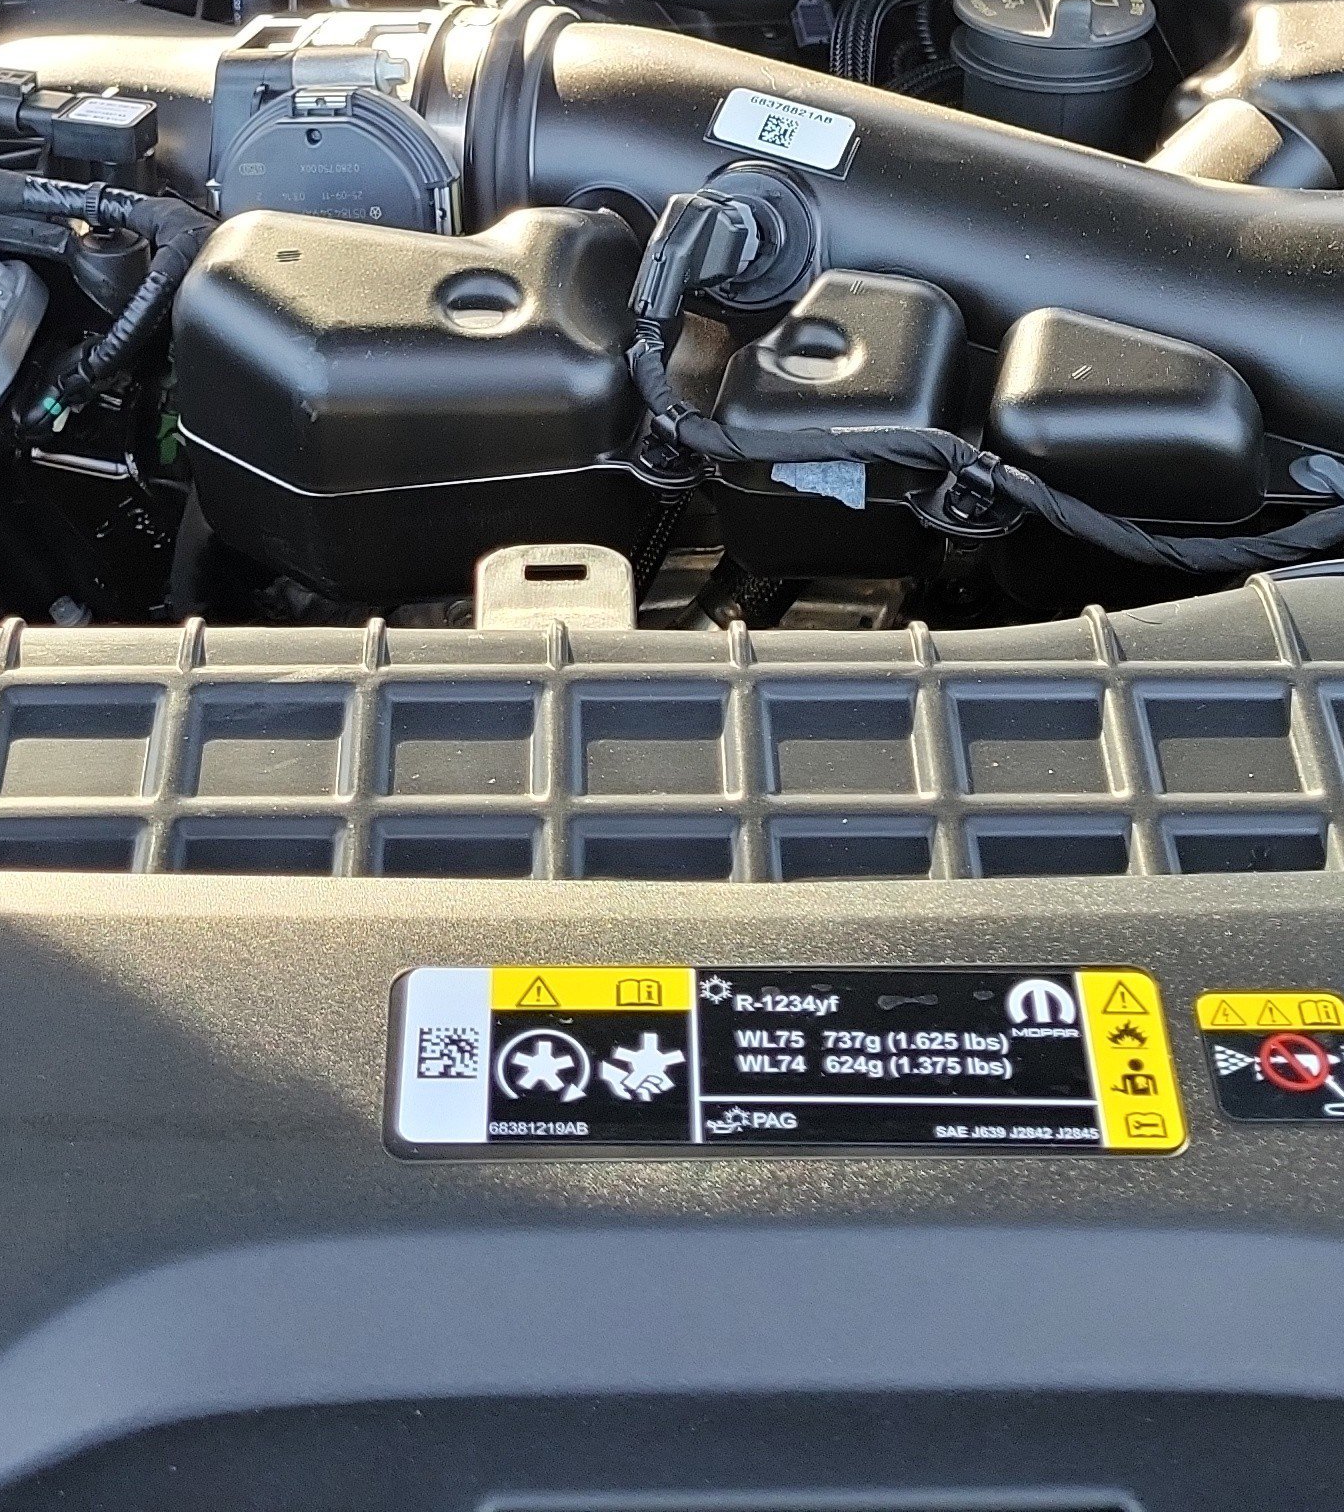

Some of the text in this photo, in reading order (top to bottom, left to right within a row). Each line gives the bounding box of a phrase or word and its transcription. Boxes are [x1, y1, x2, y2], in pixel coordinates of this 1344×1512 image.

[735, 994, 839, 1016] R-1234yf
[1011, 1027, 1080, 1038] MOPAR
[736, 1030, 1010, 1055] WL75 737g (1.625 lbs)
[737, 1054, 1013, 1080] WL74 624g (1.375 lbs)
[489, 1121, 589, 1136] 68381219AB
[752, 1112, 798, 1129] PAG
[935, 1125, 1100, 1139] SAE J639 J2842 J2845
